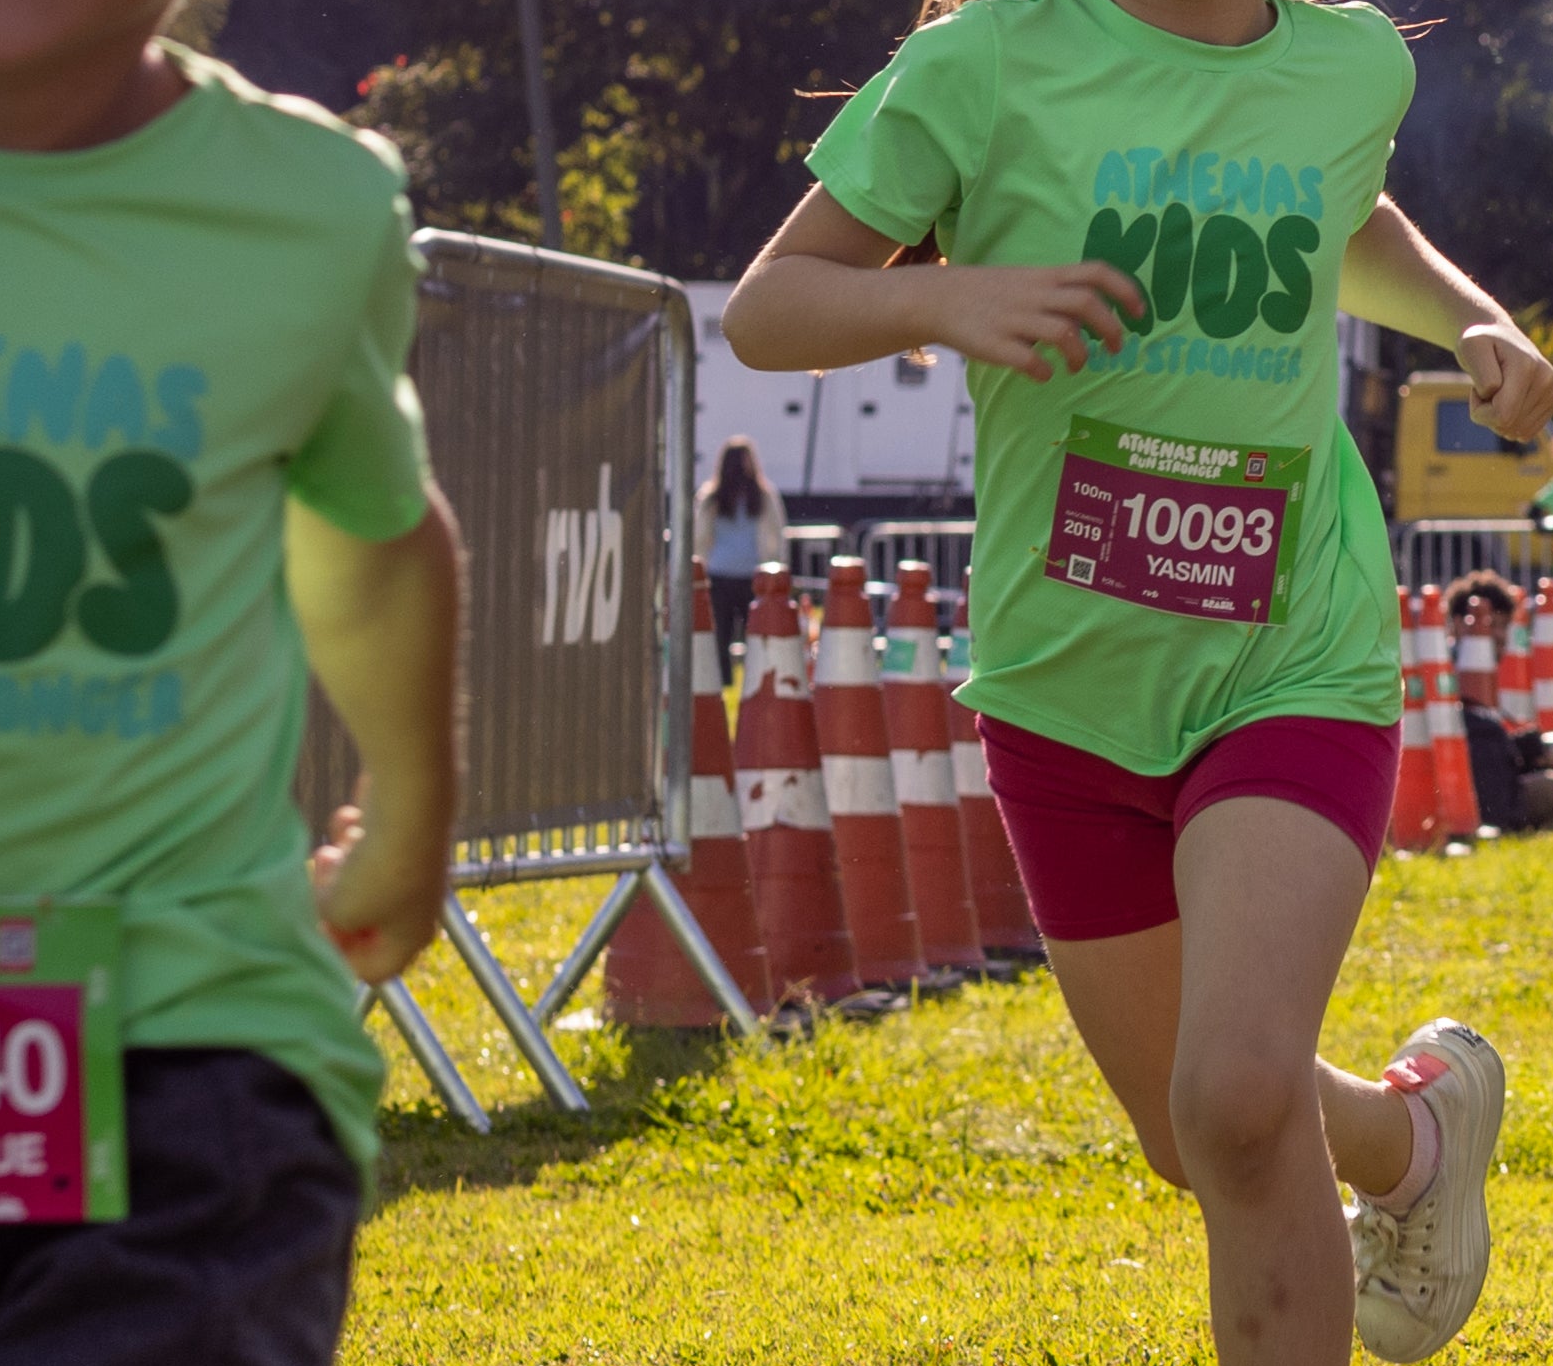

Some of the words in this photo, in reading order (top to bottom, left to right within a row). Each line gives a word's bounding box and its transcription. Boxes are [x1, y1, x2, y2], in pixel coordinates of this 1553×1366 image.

[1093, 146, 1324, 222] ATHENAS
[1081, 202, 1320, 340] KIDS
[1085, 335, 1139, 375] UN
[1144, 335, 1302, 385] STRONGER
[1118, 432, 1196, 464] ATHENAS
[1199, 445, 1240, 469] KIDS
[1128, 452, 1157, 471] RUN
[1156, 457, 1222, 480] STRONGER
[1072, 480, 1113, 503] 100m
[1063, 519, 1102, 542] 2019
[1121, 492, 1275, 557] 10093
[543, 462, 623, 646] rvb
[1146, 554, 1236, 587] YASMIN
